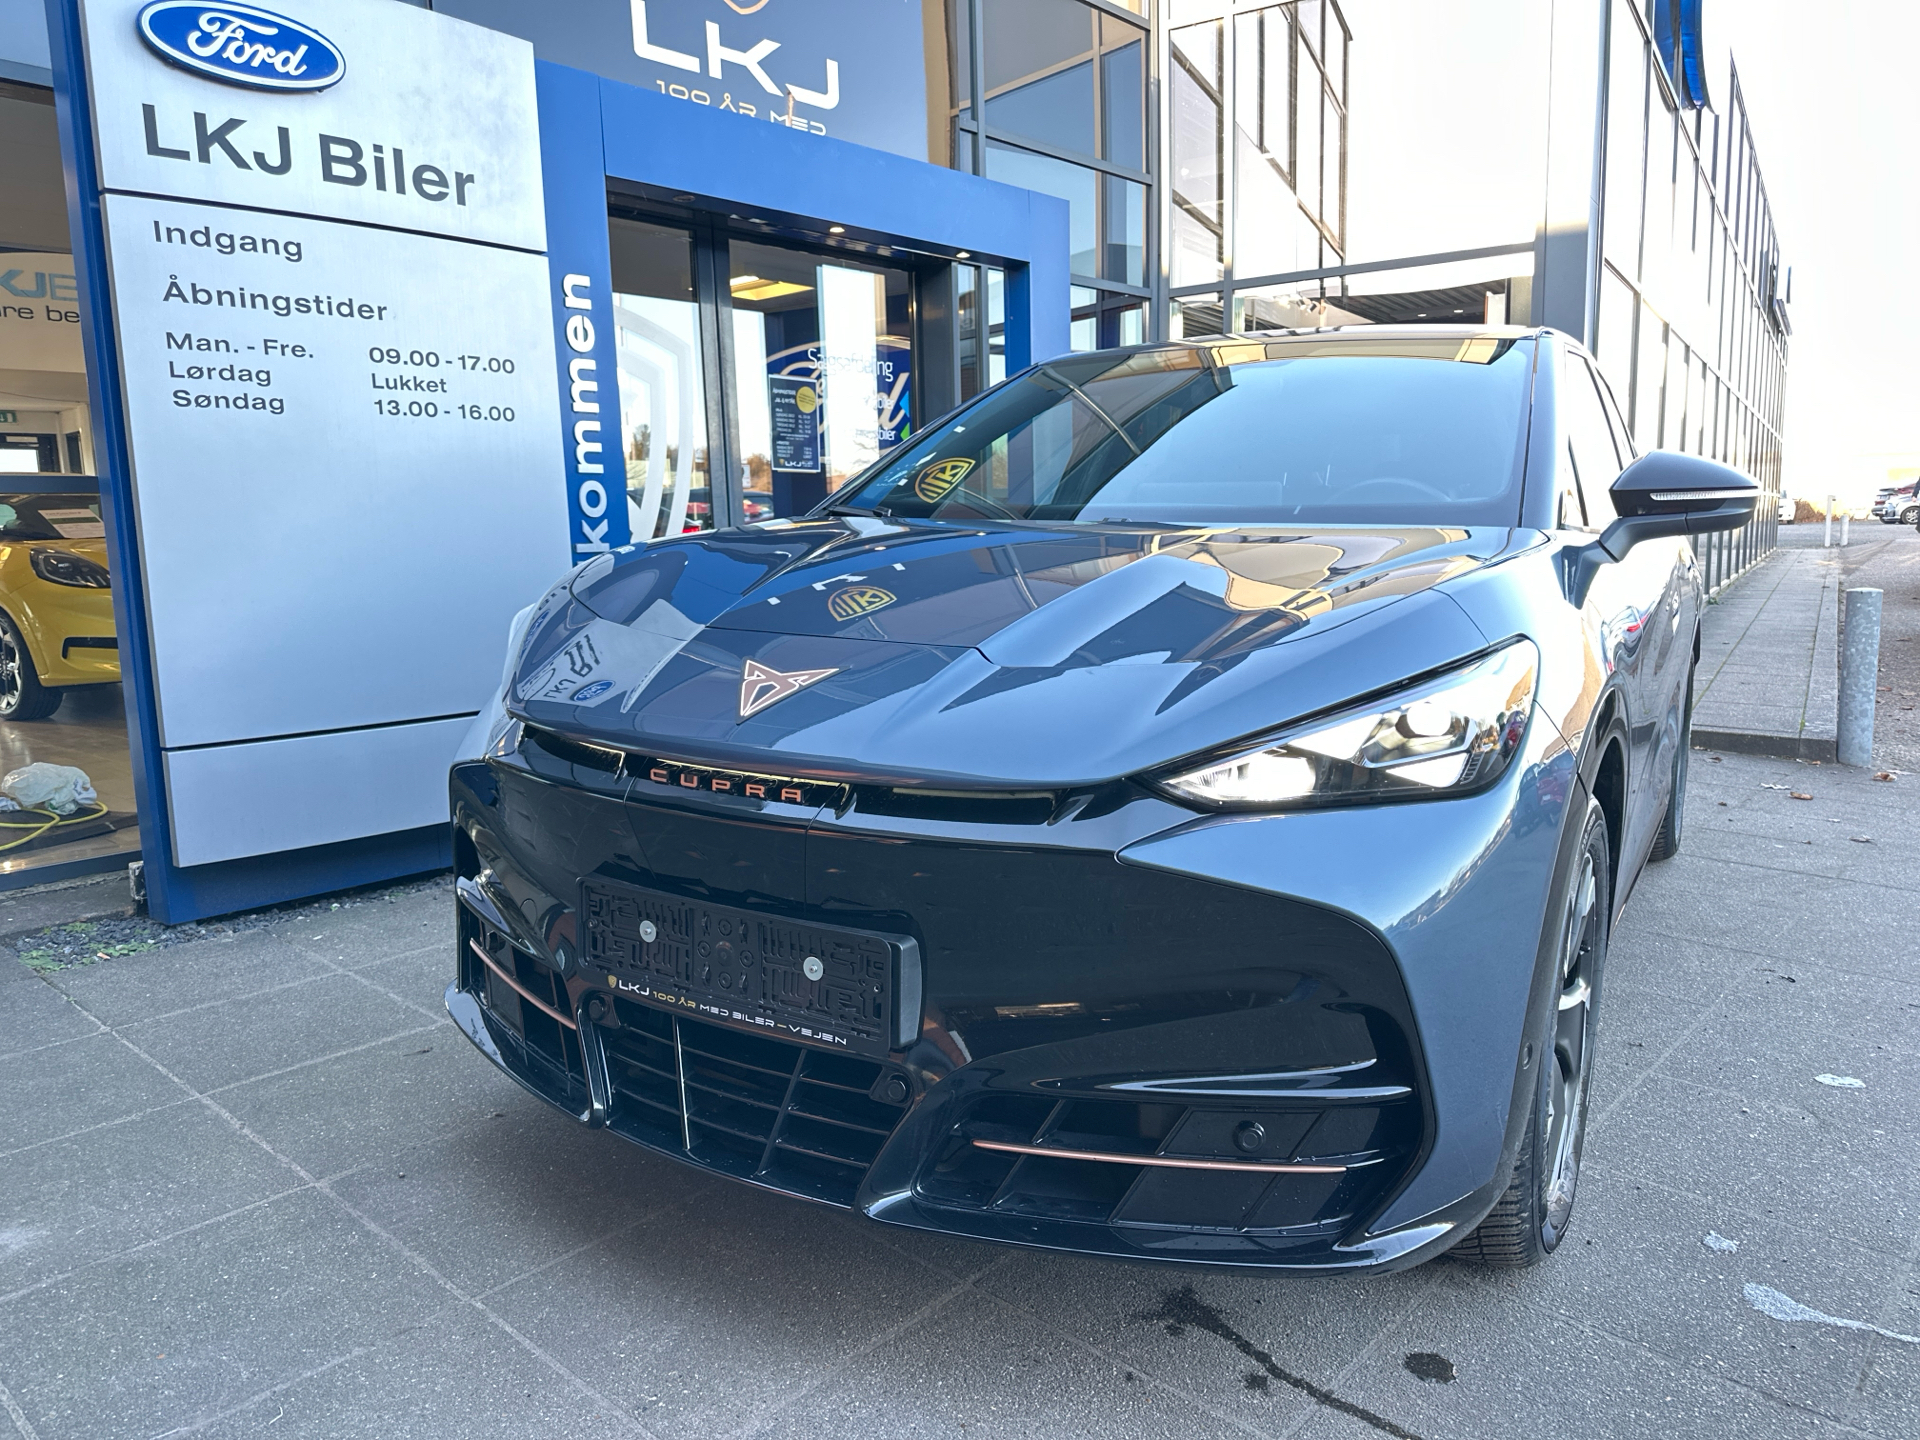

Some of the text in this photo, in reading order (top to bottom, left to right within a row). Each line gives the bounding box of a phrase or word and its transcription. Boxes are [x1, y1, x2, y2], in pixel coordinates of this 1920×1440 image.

[187, 11, 309, 76] Ford
[630, 0, 840, 110] LKJ
[656, 79, 711, 106] 100
[769, 109, 827, 137] MED
[141, 102, 475, 207] LKJ Biler
[153, 220, 303, 263] Indgang
[0, 305, 34, 320] re
[162, 274, 388, 321] Åbningstider
[166, 331, 239, 354] Man.
[263, 338, 314, 359] Fre.
[369, 346, 440, 368] 09.00
[457, 354, 515, 374] 17.00
[168, 360, 448, 393] Lørdag Lukket
[172, 389, 285, 415] Søndag
[373, 399, 438, 418] 13.00
[457, 404, 515, 422] 16.00
[563, 273, 610, 567] kommen
[650, 767, 803, 803] CUPRA
[618, 979, 650, 996] LKJ
[652, 991, 676, 1004] 100
[677, 996, 697, 1009] ÅR
[699, 1003, 730, 1017] MED
[732, 1011, 775, 1028] BILER
[788, 1024, 847, 1046] VEJEN
